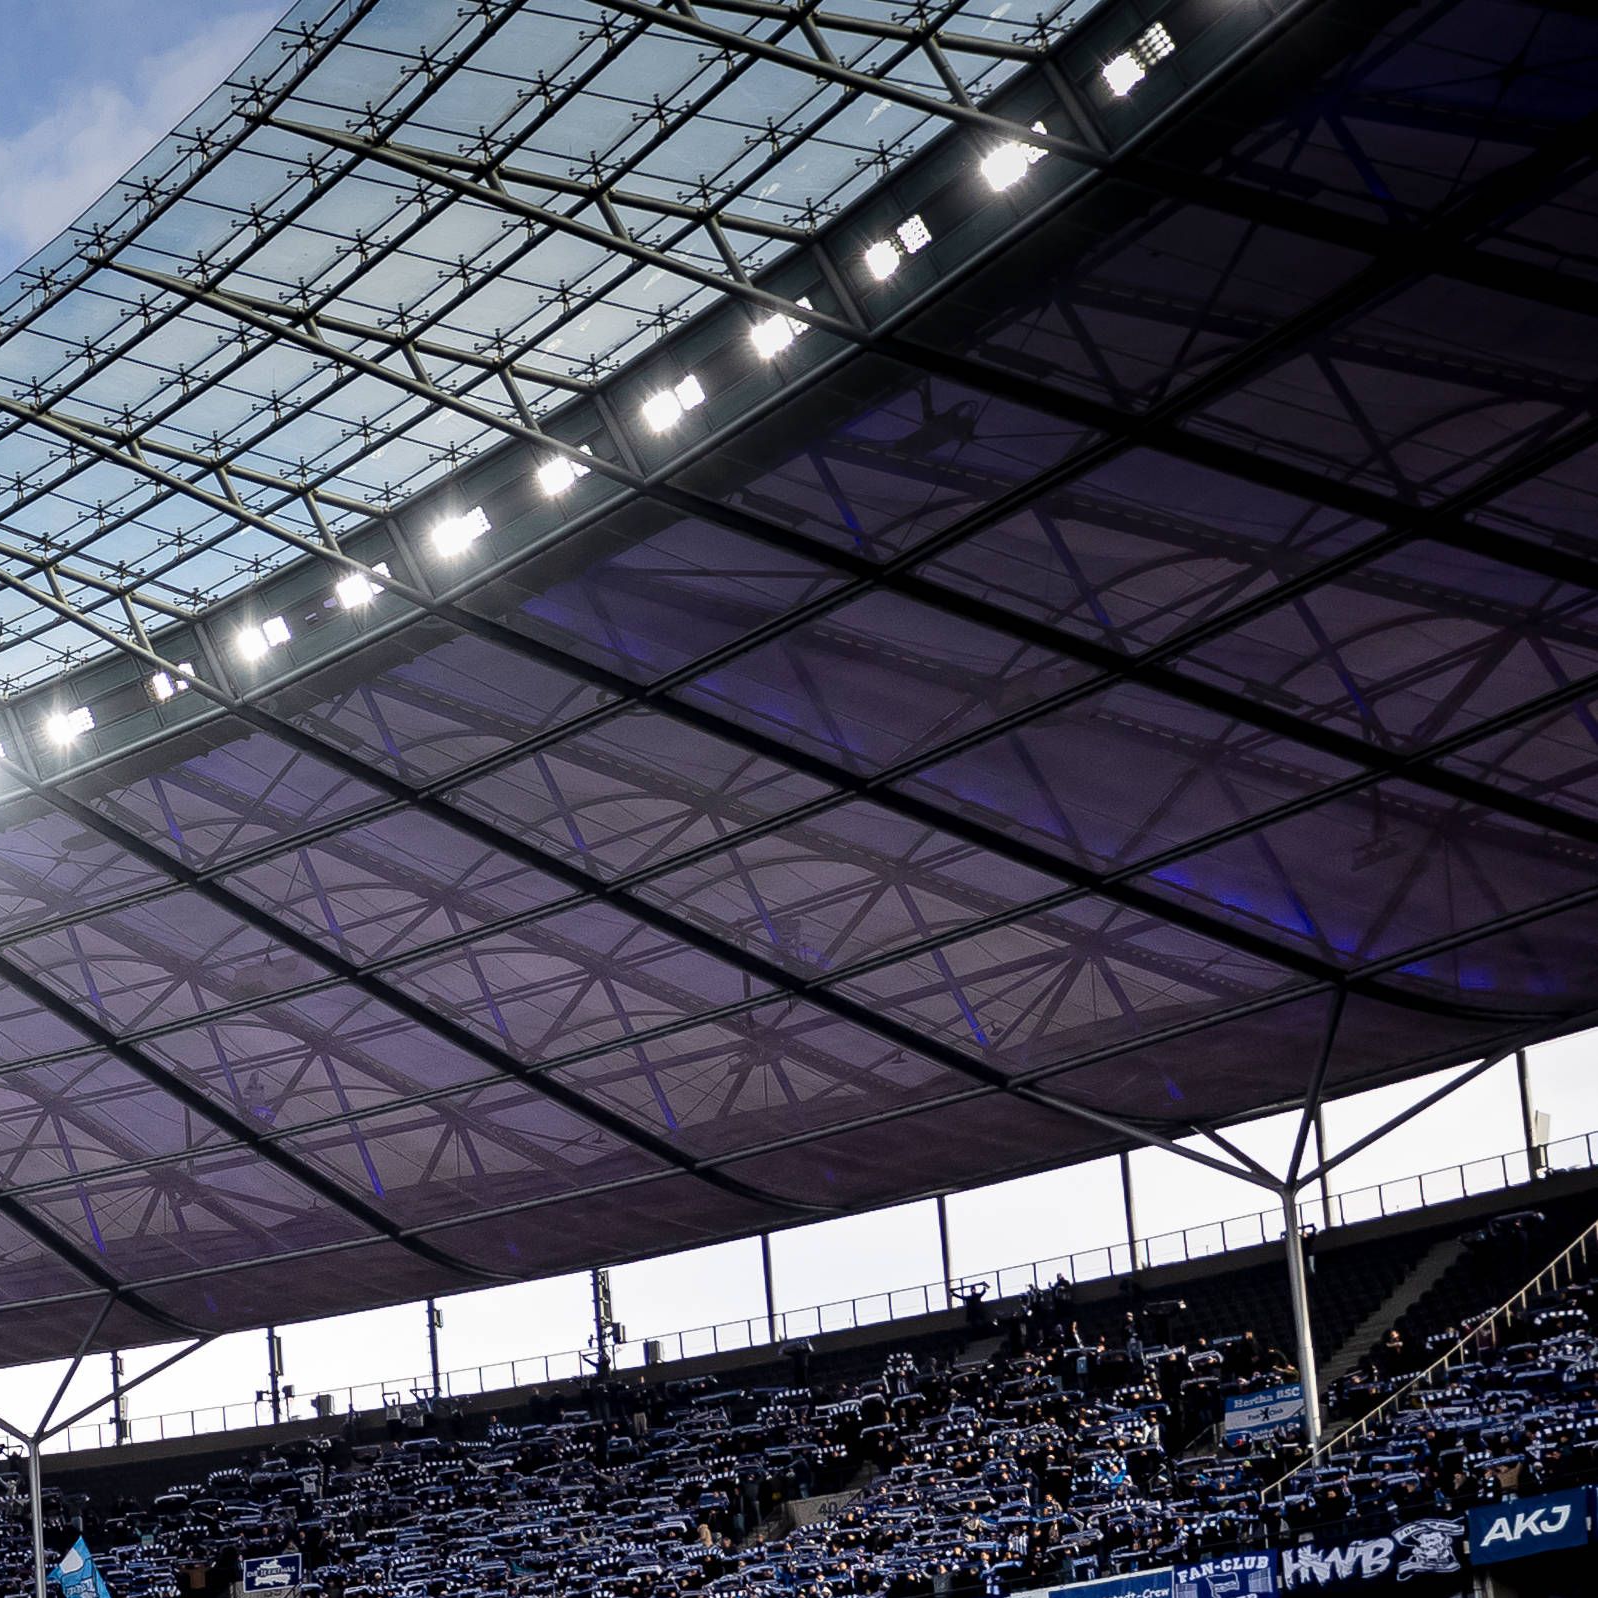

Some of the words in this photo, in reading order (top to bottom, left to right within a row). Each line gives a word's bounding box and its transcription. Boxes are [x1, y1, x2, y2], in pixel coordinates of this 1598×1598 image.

[1275, 1386, 1301, 1400] BSC
[1480, 1504, 1571, 1547] AKJ
[1177, 1555, 1269, 1584] FAN-CLUB
